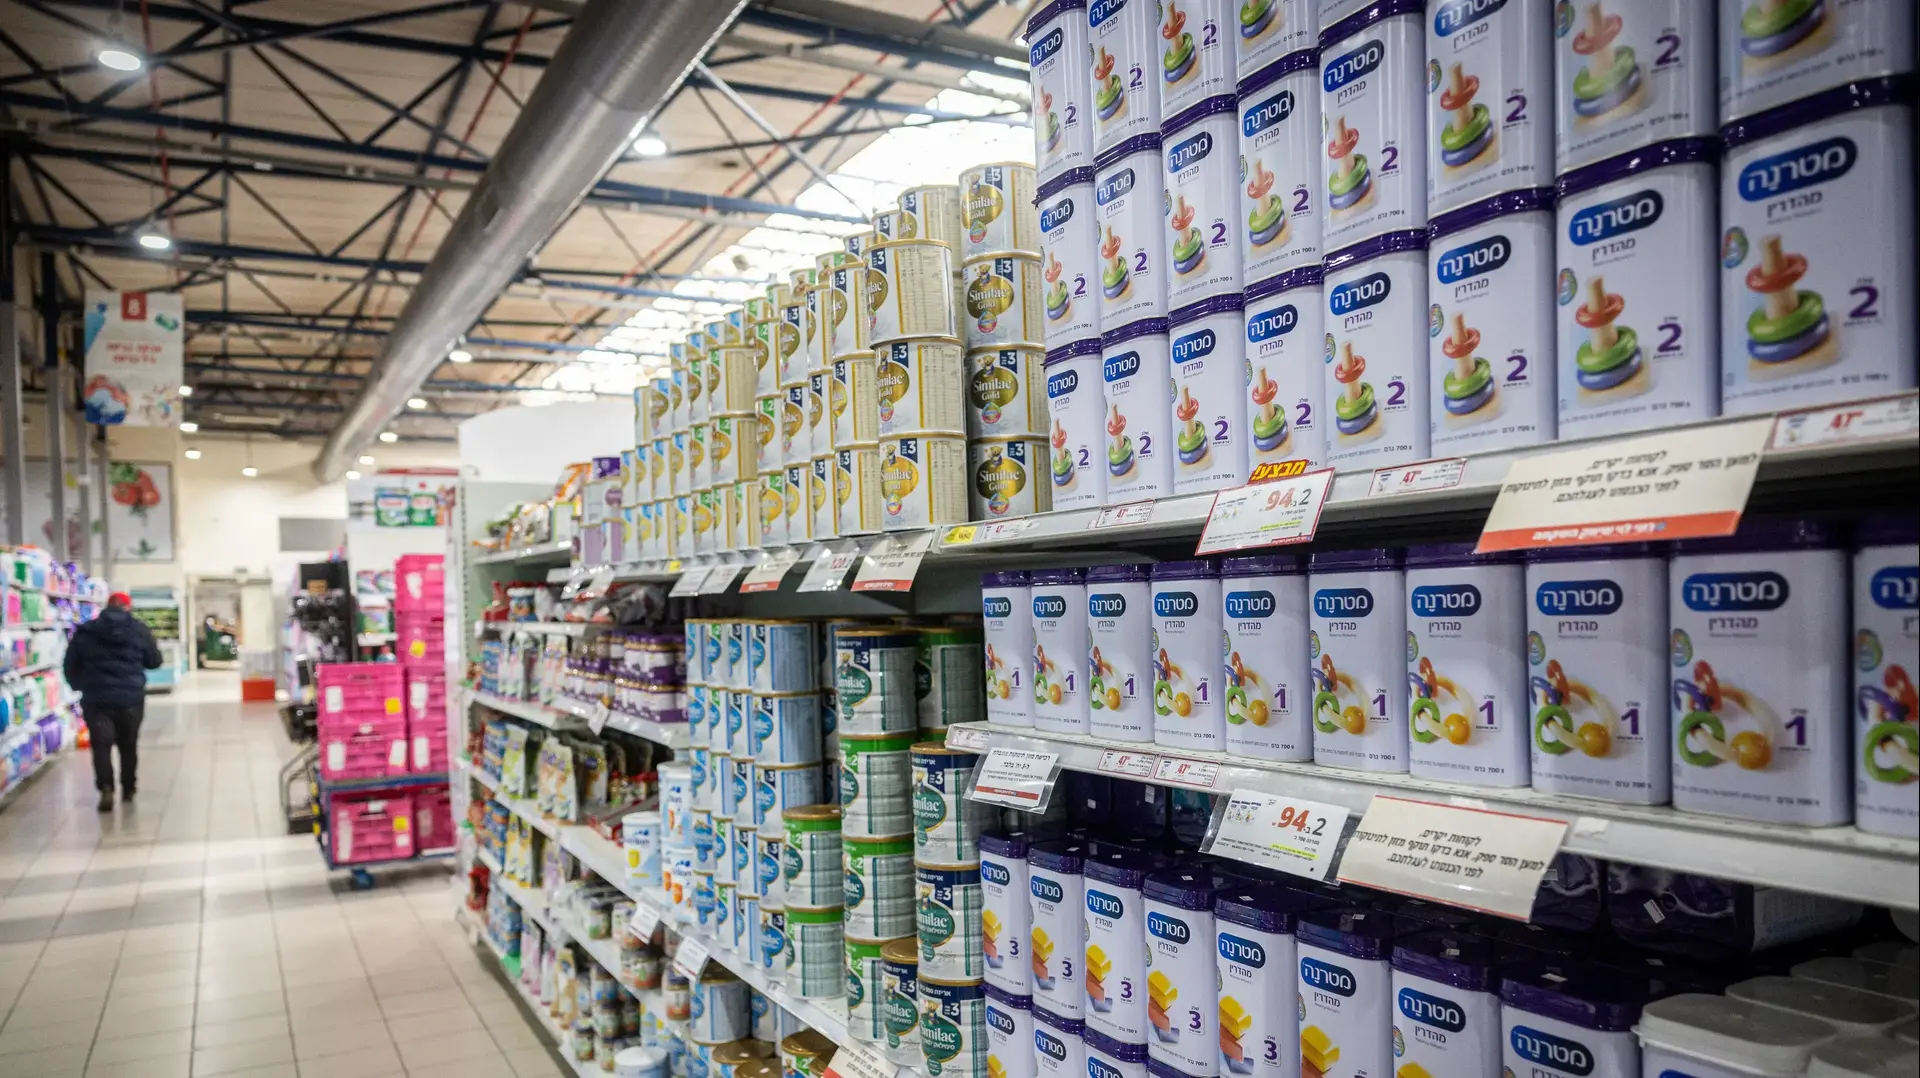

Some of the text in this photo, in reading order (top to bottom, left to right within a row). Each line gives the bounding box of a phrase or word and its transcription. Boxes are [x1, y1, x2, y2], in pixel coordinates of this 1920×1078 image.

[1202, 24, 1217, 47] 2
[1654, 33, 1681, 67] 2
[1129, 67, 1143, 89] 2
[1065, 105, 1077, 125] 2
[1505, 94, 1528, 123] 2
[1380, 146, 1399, 172] 2
[1292, 188, 1309, 213] 2
[1211, 222, 1227, 244] 2
[1134, 252, 1148, 272] 2
[1074, 277, 1086, 296] 2
[1454, 278, 1489, 298] מהדרין
[1847, 285, 1880, 319] 2
[1344, 311, 1373, 329] מהדרין
[1656, 322, 1683, 352] 2
[1506, 354, 1528, 382] 2
[1386, 381, 1406, 405] 2
[1295, 402, 1312, 426] 2
[1214, 420, 1229, 441] 2
[1139, 435, 1152, 455] 2
[1078, 448, 1090, 467] 2
[1265, 487, 1295, 512] 94
[1298, 488, 1312, 506] 2
[1329, 621, 1356, 632] מהדרין
[1428, 621, 1462, 632] מהדרין
[1558, 621, 1598, 633] מהדרין
[861, 651, 869, 664] 3
[1373, 695, 1386, 716] 1
[1478, 701, 1494, 725] 1
[1621, 709, 1639, 735] 1
[1784, 716, 1806, 746] 1
[935, 771, 944, 785] 3
[1277, 806, 1310, 833] 94
[1311, 817, 1327, 836] 2
[1388, 837, 1405, 848] מזון
[1407, 840, 1430, 852] תוקף
[1419, 828, 1482, 847] לקוחות יקרים,
[1431, 844, 1452, 856] בדקו
[1455, 850, 1472, 860] אנא
[1463, 867, 1484, 878] לפני
[1518, 859, 1545, 871] למען
[942, 887, 951, 901] 3
[1229, 964, 1252, 979] מהדרין
[907, 980, 915, 993] 3
[950, 1002, 960, 1016] 3
[1314, 991, 1341, 1008] מהדרין
[1189, 1010, 1201, 1030] 3
[1415, 1024, 1446, 1044] מהדרין
[1264, 1039, 1278, 1061] 3
